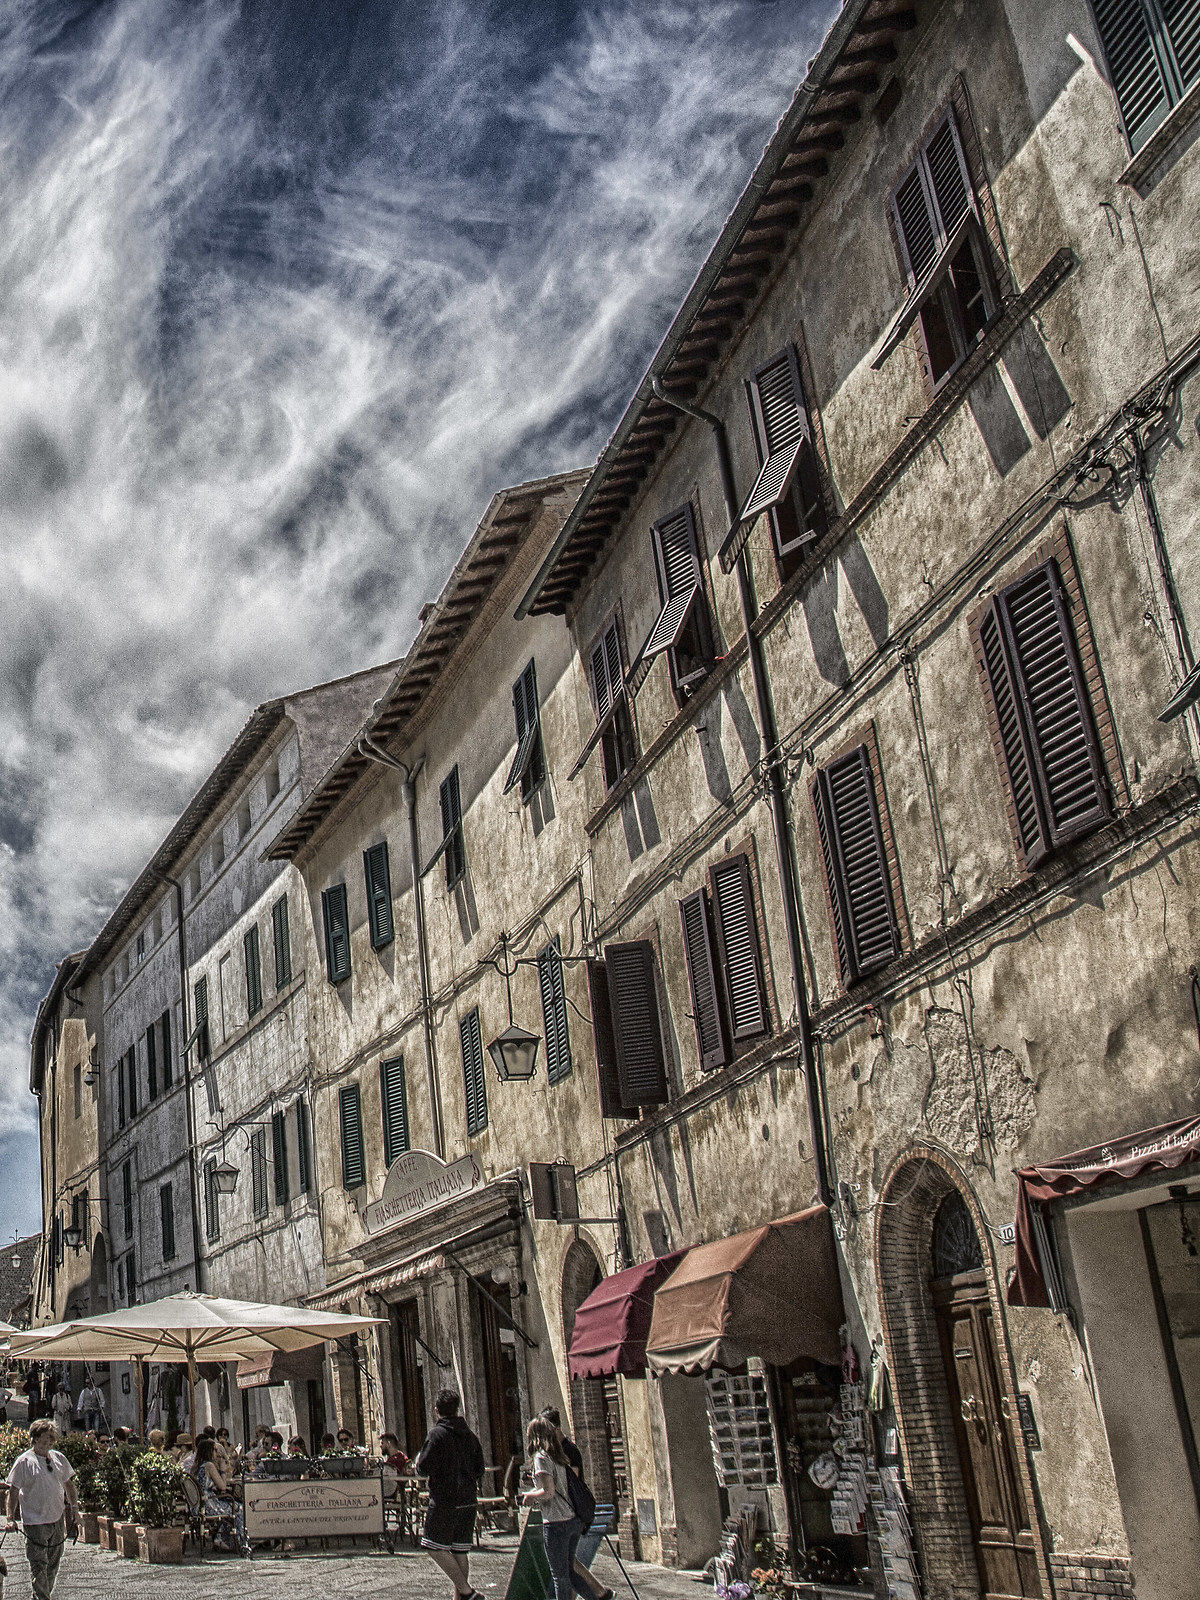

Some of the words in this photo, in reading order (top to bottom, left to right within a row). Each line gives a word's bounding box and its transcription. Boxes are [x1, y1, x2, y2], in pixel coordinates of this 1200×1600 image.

[1131, 1142, 1158, 1159] Pizza
[374, 1187, 427, 1225] FIASCHETTERIA
[426, 1169, 465, 1201] ITALIANA
[1003, 1227, 1013, 1239] 10
[267, 1500, 323, 1508] FIASCHETTERIA
[328, 1499, 362, 1507] ITALIANA
